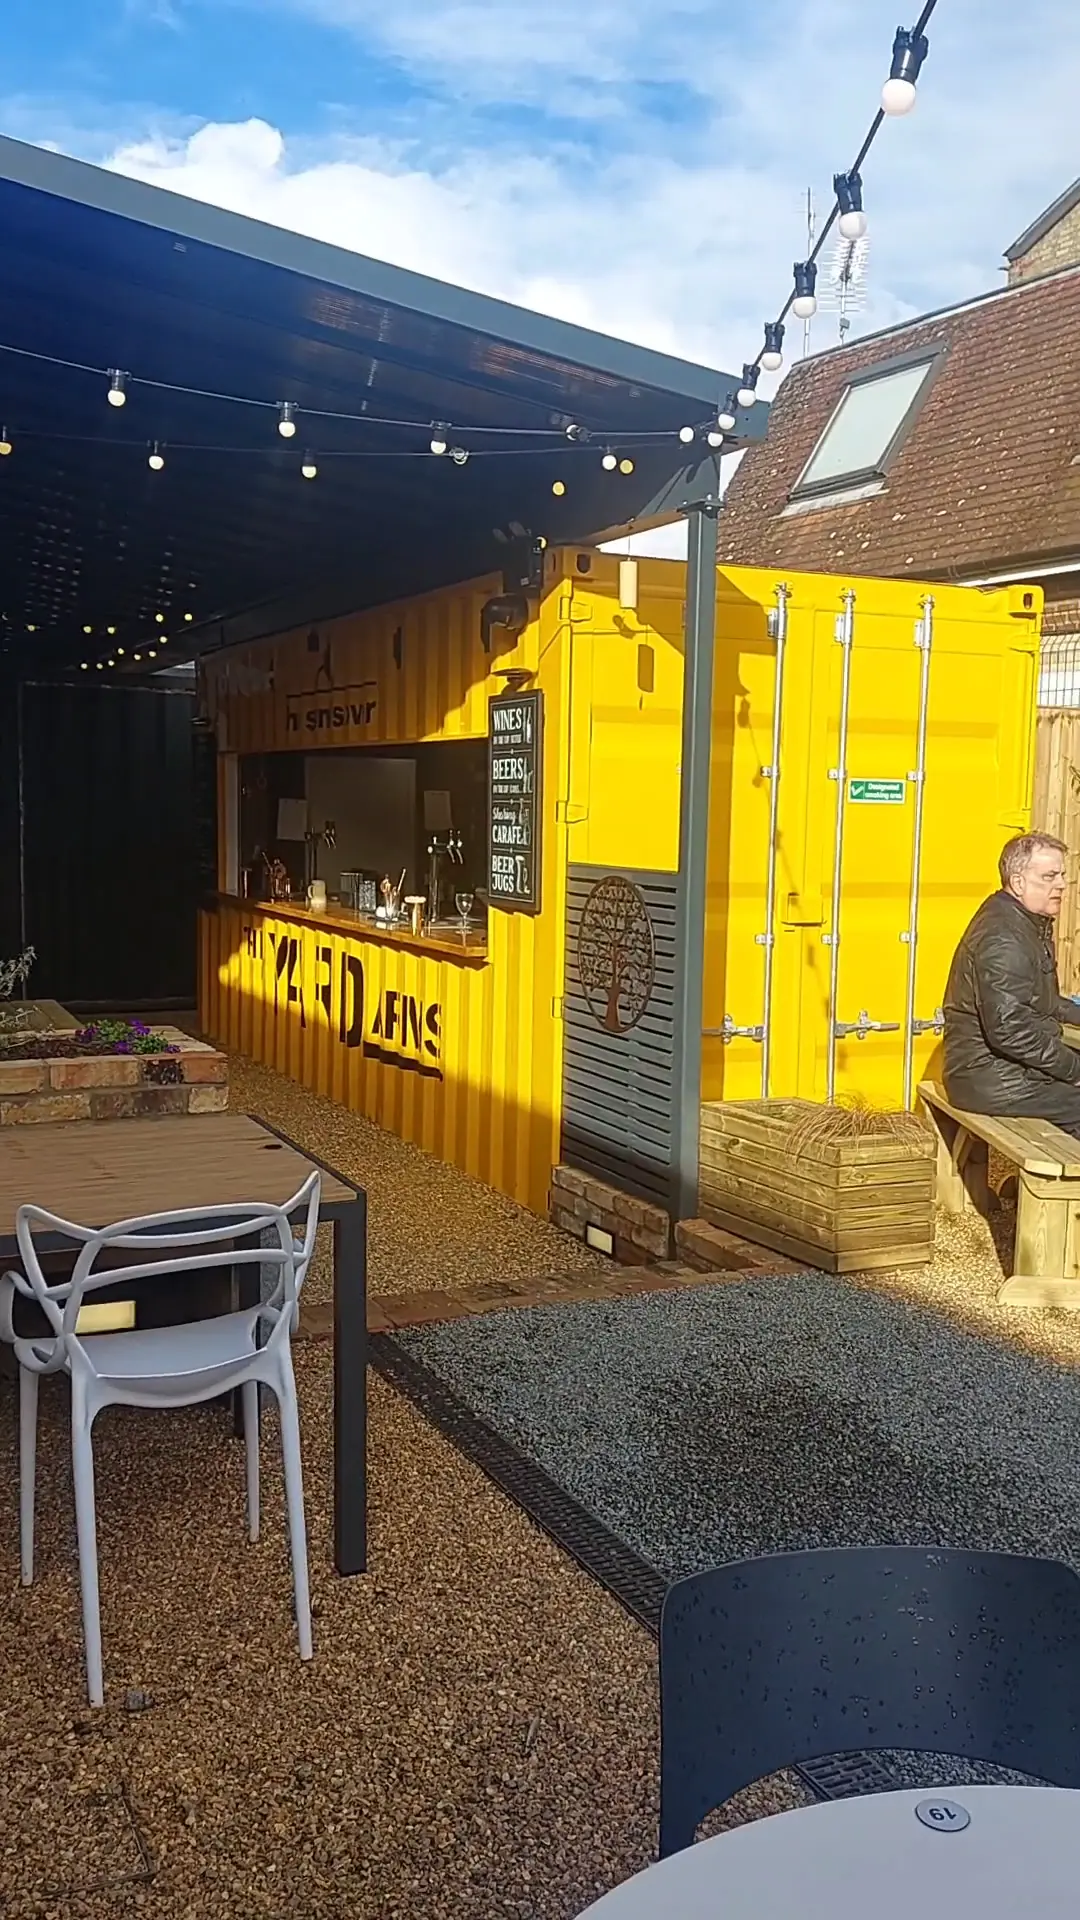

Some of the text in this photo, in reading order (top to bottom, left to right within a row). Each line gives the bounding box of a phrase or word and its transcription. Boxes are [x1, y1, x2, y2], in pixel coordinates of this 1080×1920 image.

[493, 708, 522, 732] WINES
[492, 758, 524, 780] BEERS
[492, 855, 515, 874] BEER
[492, 874, 515, 894] JUGS
[929, 1807, 957, 1821] 19
